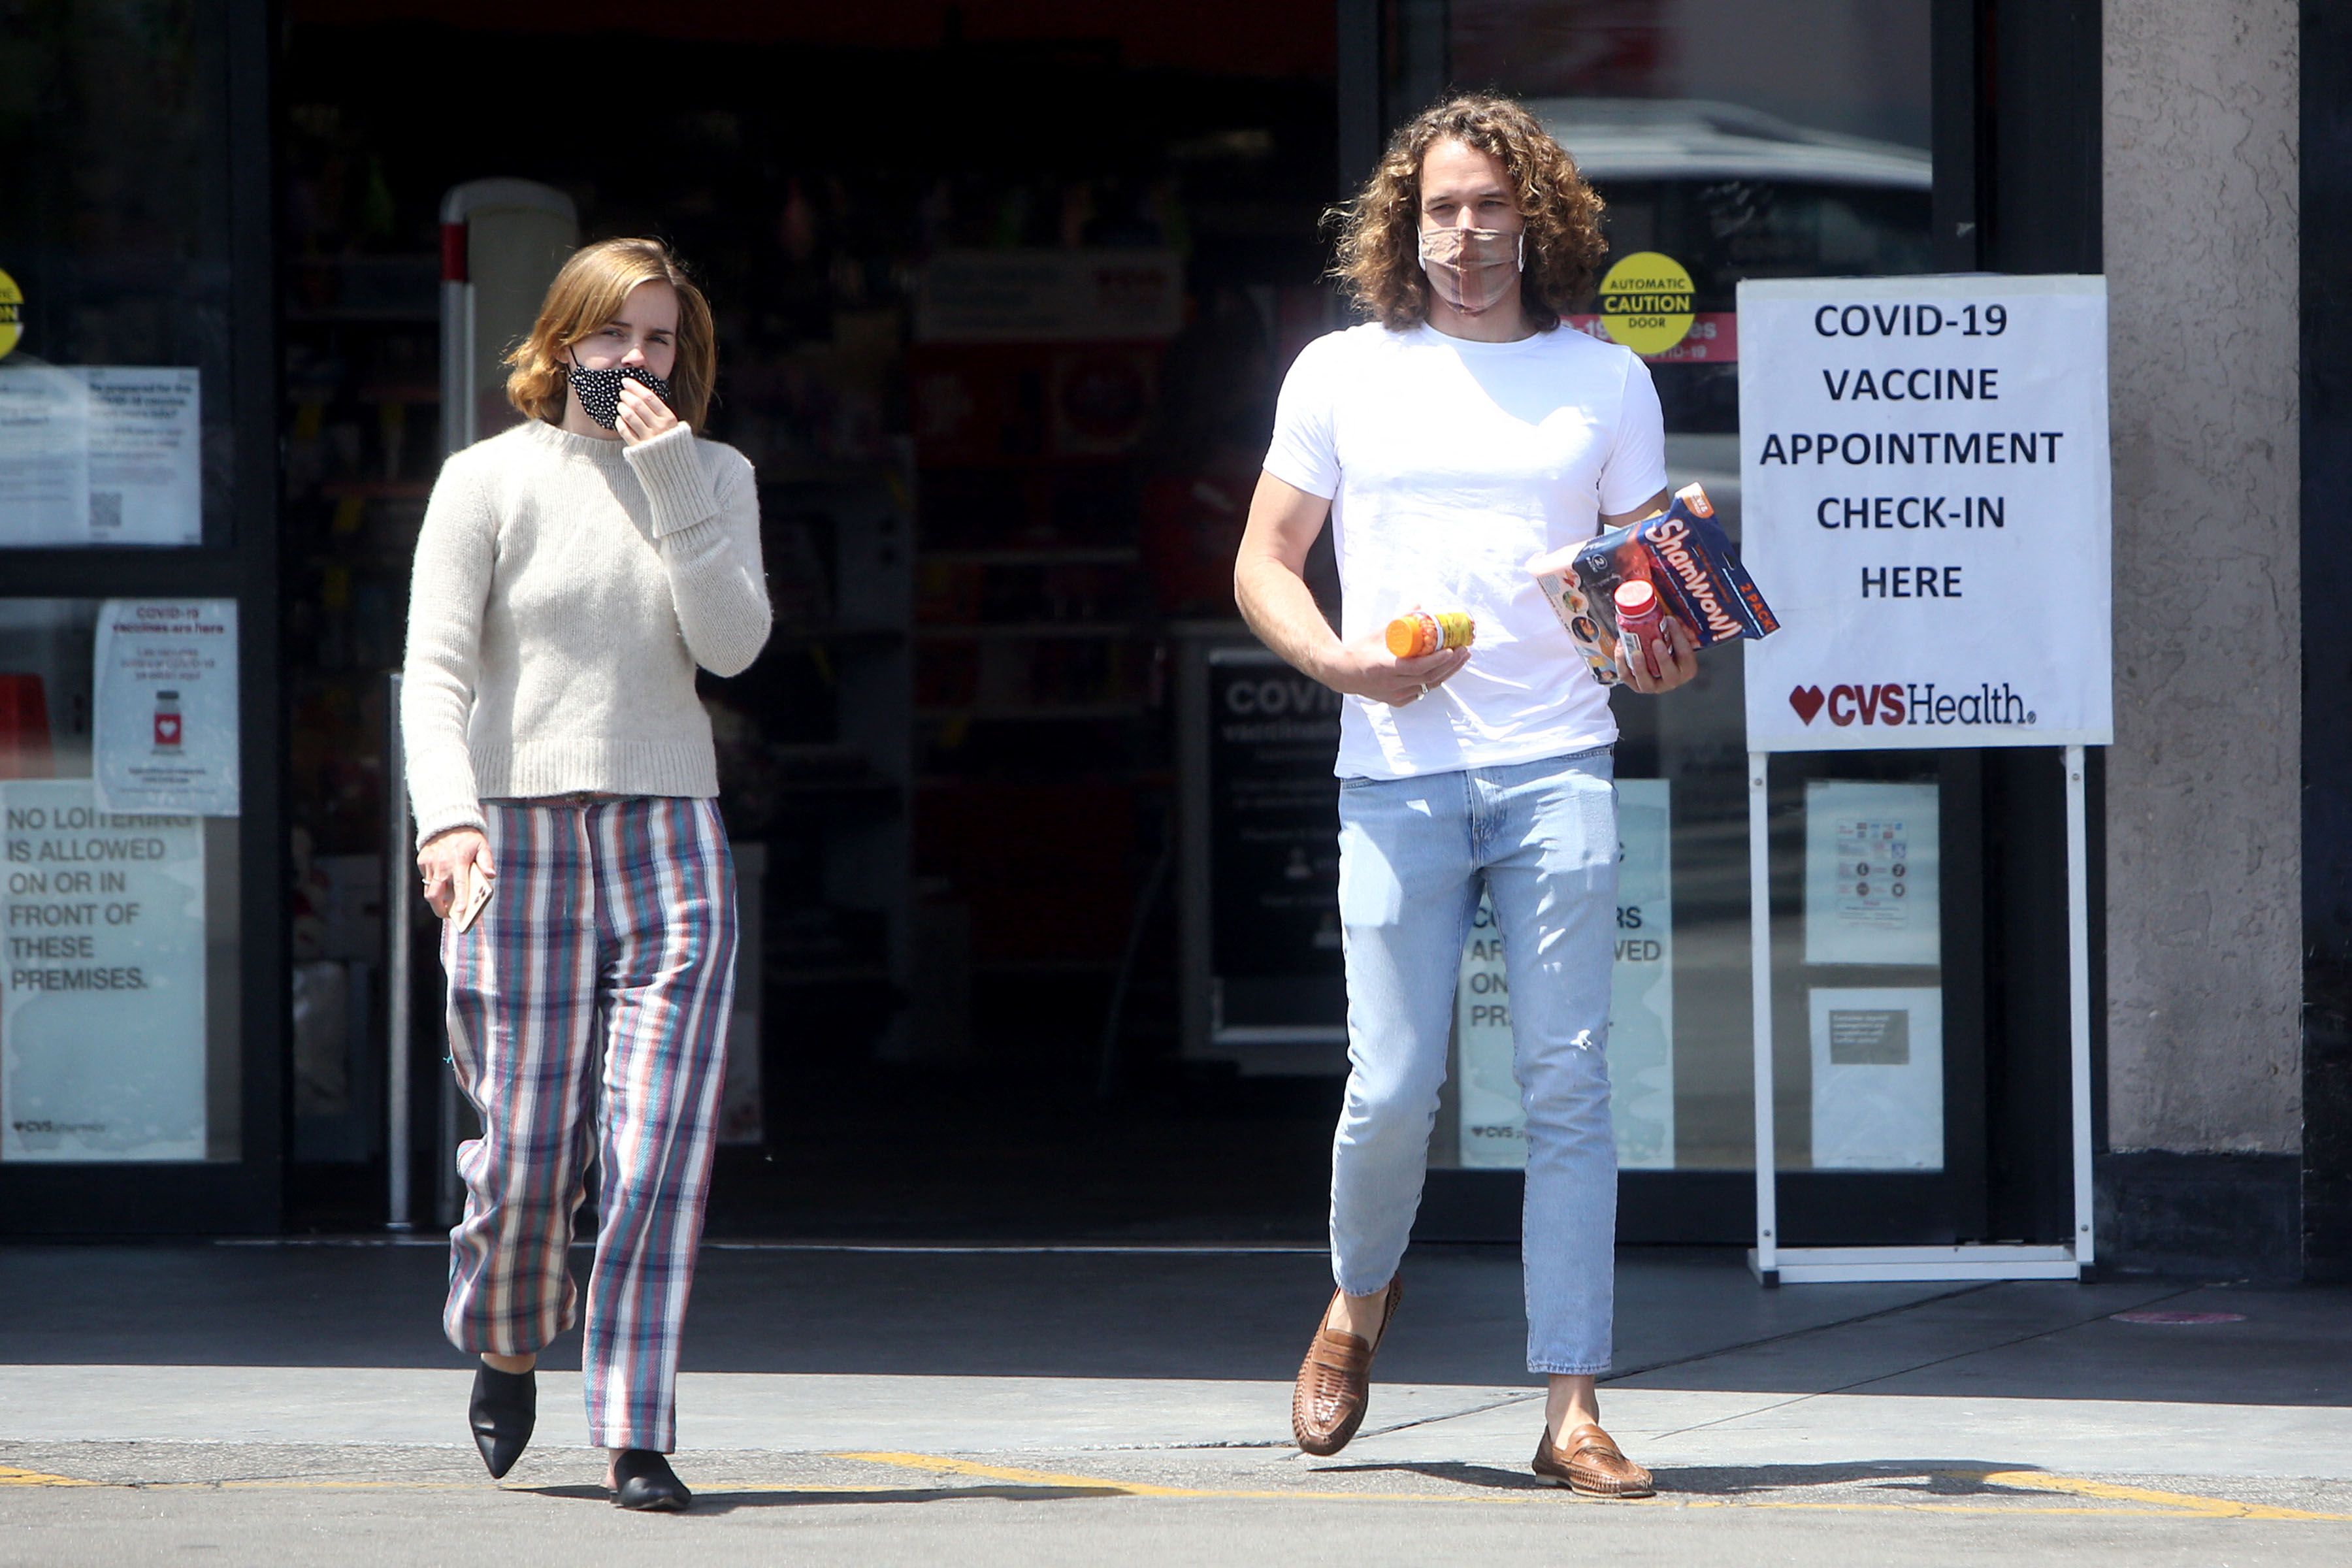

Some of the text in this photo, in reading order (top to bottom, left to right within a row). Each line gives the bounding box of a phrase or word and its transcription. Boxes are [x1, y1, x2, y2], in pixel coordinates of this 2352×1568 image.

[1610, 278, 1686, 289] AUTOMATIC
[1605, 295, 1690, 313] CAUTION
[1628, 318, 1666, 329] DOOR
[1814, 304, 2008, 337] COVID-19
[1823, 368, 1999, 400] VACCINE
[1759, 432, 2064, 465] APPOINTMENT
[1816, 497, 2006, 529] CHECK-IN
[1740, 583, 1752, 594] 2
[1862, 566, 1963, 598] HERE
[7, 808, 46, 830] NO
[8, 838, 165, 862] IS ALLOWED
[9, 871, 126, 895] ON OR IN
[10, 902, 140, 927] FRONT OF
[10, 936, 94, 958] THESE
[11, 968, 148, 992] PREMISES.
